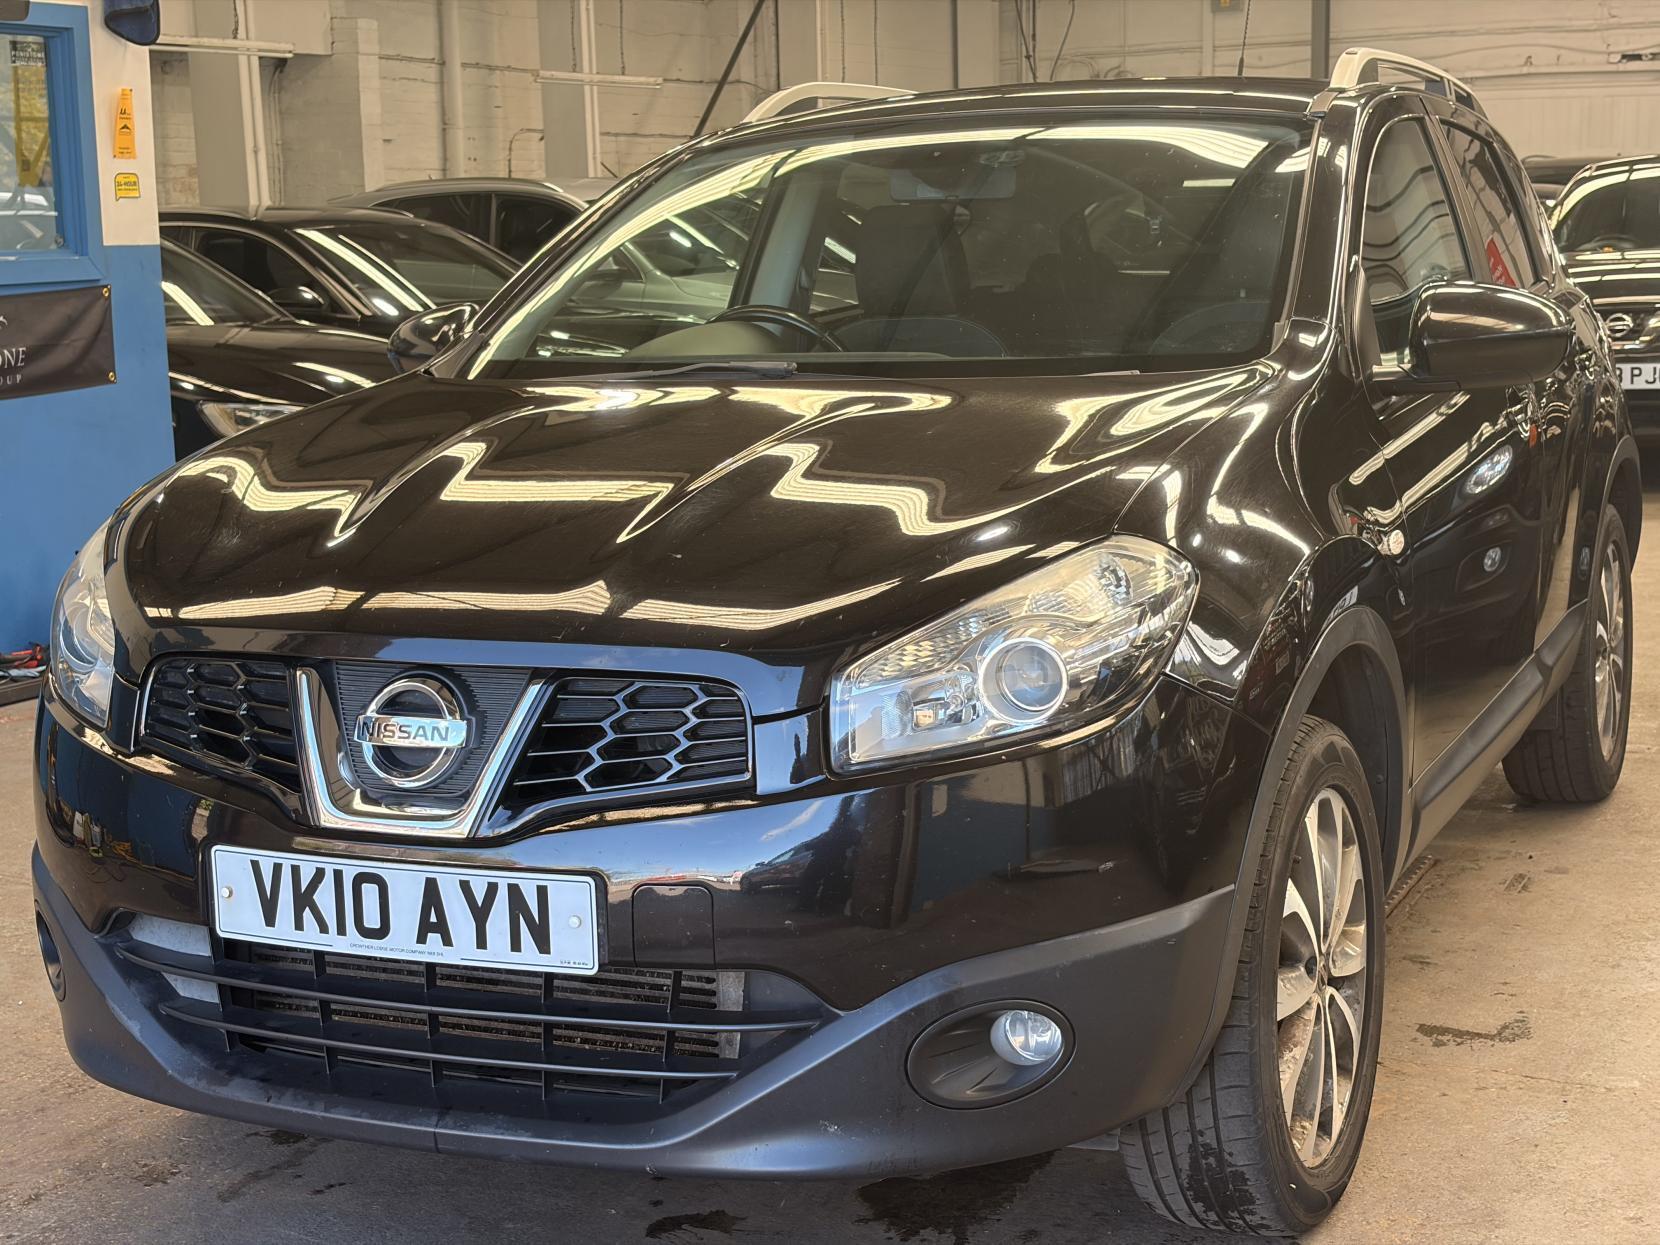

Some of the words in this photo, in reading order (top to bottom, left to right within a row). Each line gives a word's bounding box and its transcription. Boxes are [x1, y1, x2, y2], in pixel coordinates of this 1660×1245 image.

[1630, 366, 1660, 385] PJ
[361, 721, 449, 742] NISSAN
[250, 859, 391, 941] VK10
[416, 876, 552, 955] AYN
